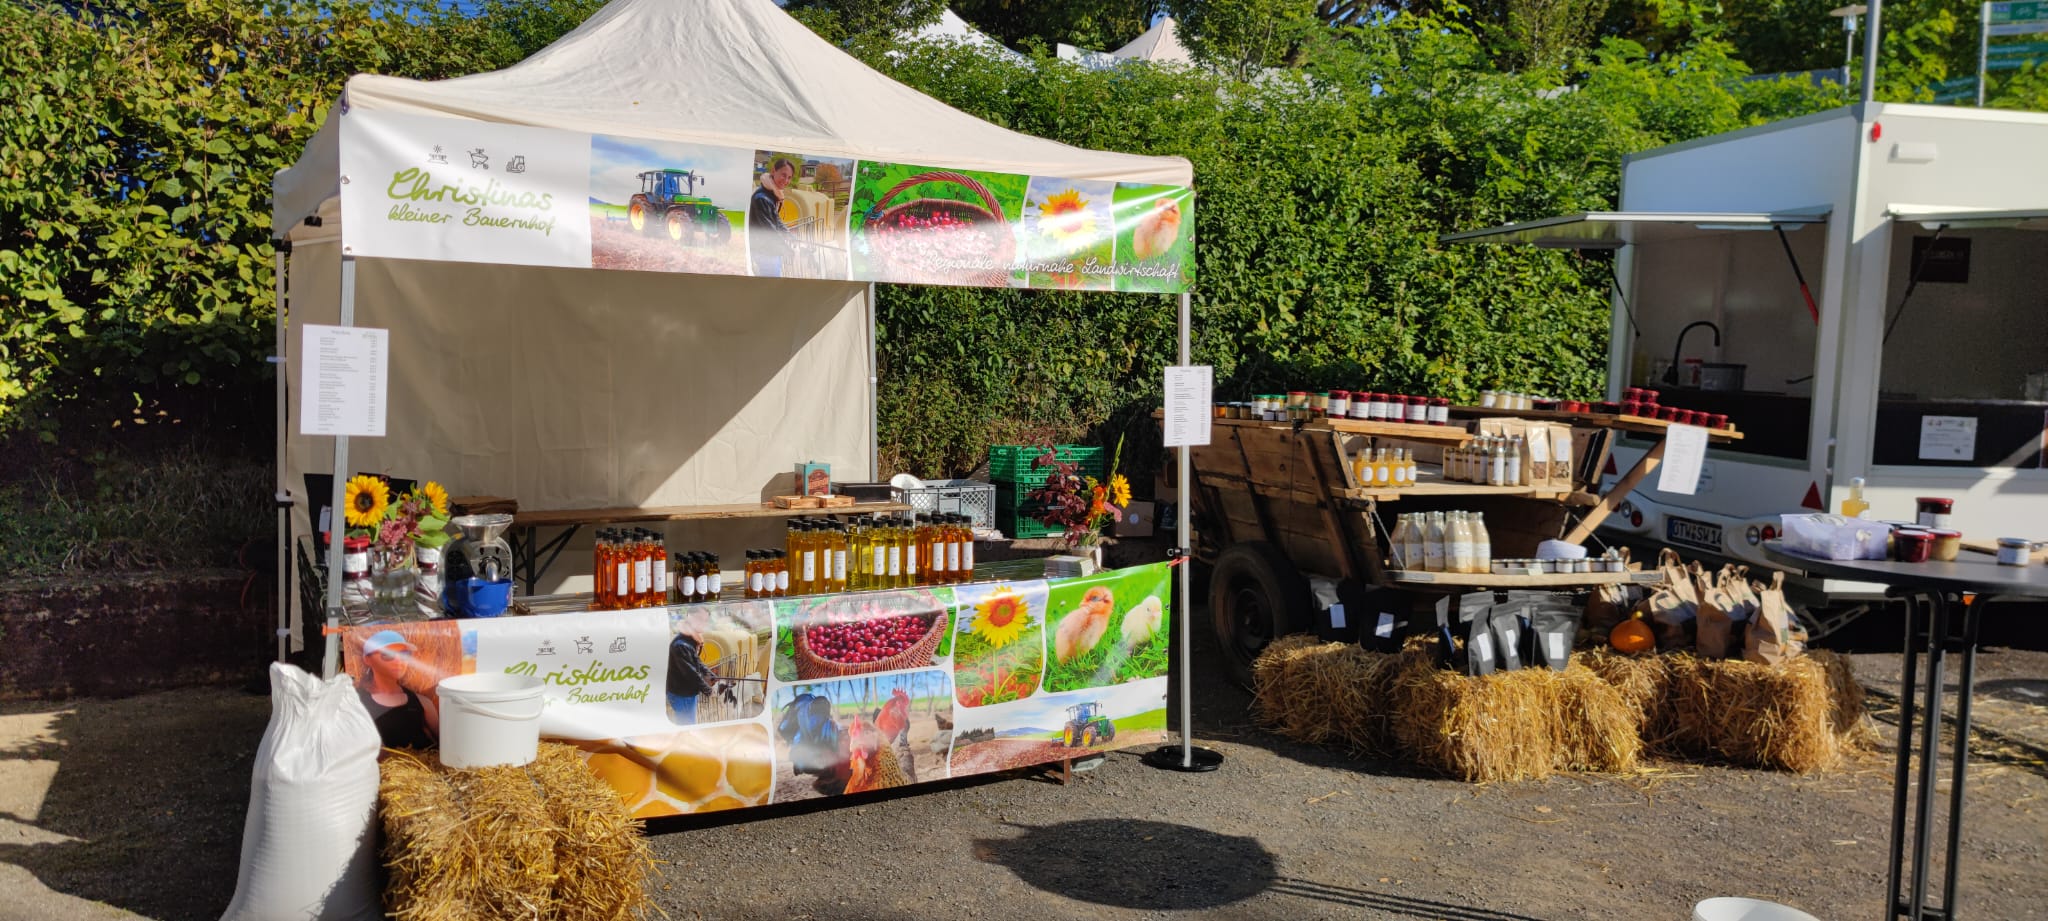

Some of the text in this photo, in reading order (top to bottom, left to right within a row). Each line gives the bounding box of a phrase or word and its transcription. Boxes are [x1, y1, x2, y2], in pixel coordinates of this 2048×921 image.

[387, 167, 552, 210] Christinas
[388, 203, 557, 237] kleiner Bauernhof
[926, 250, 1181, 283] Regionale naturnahe Landwirtschaft
[566, 683, 651, 705] Bauernhof
